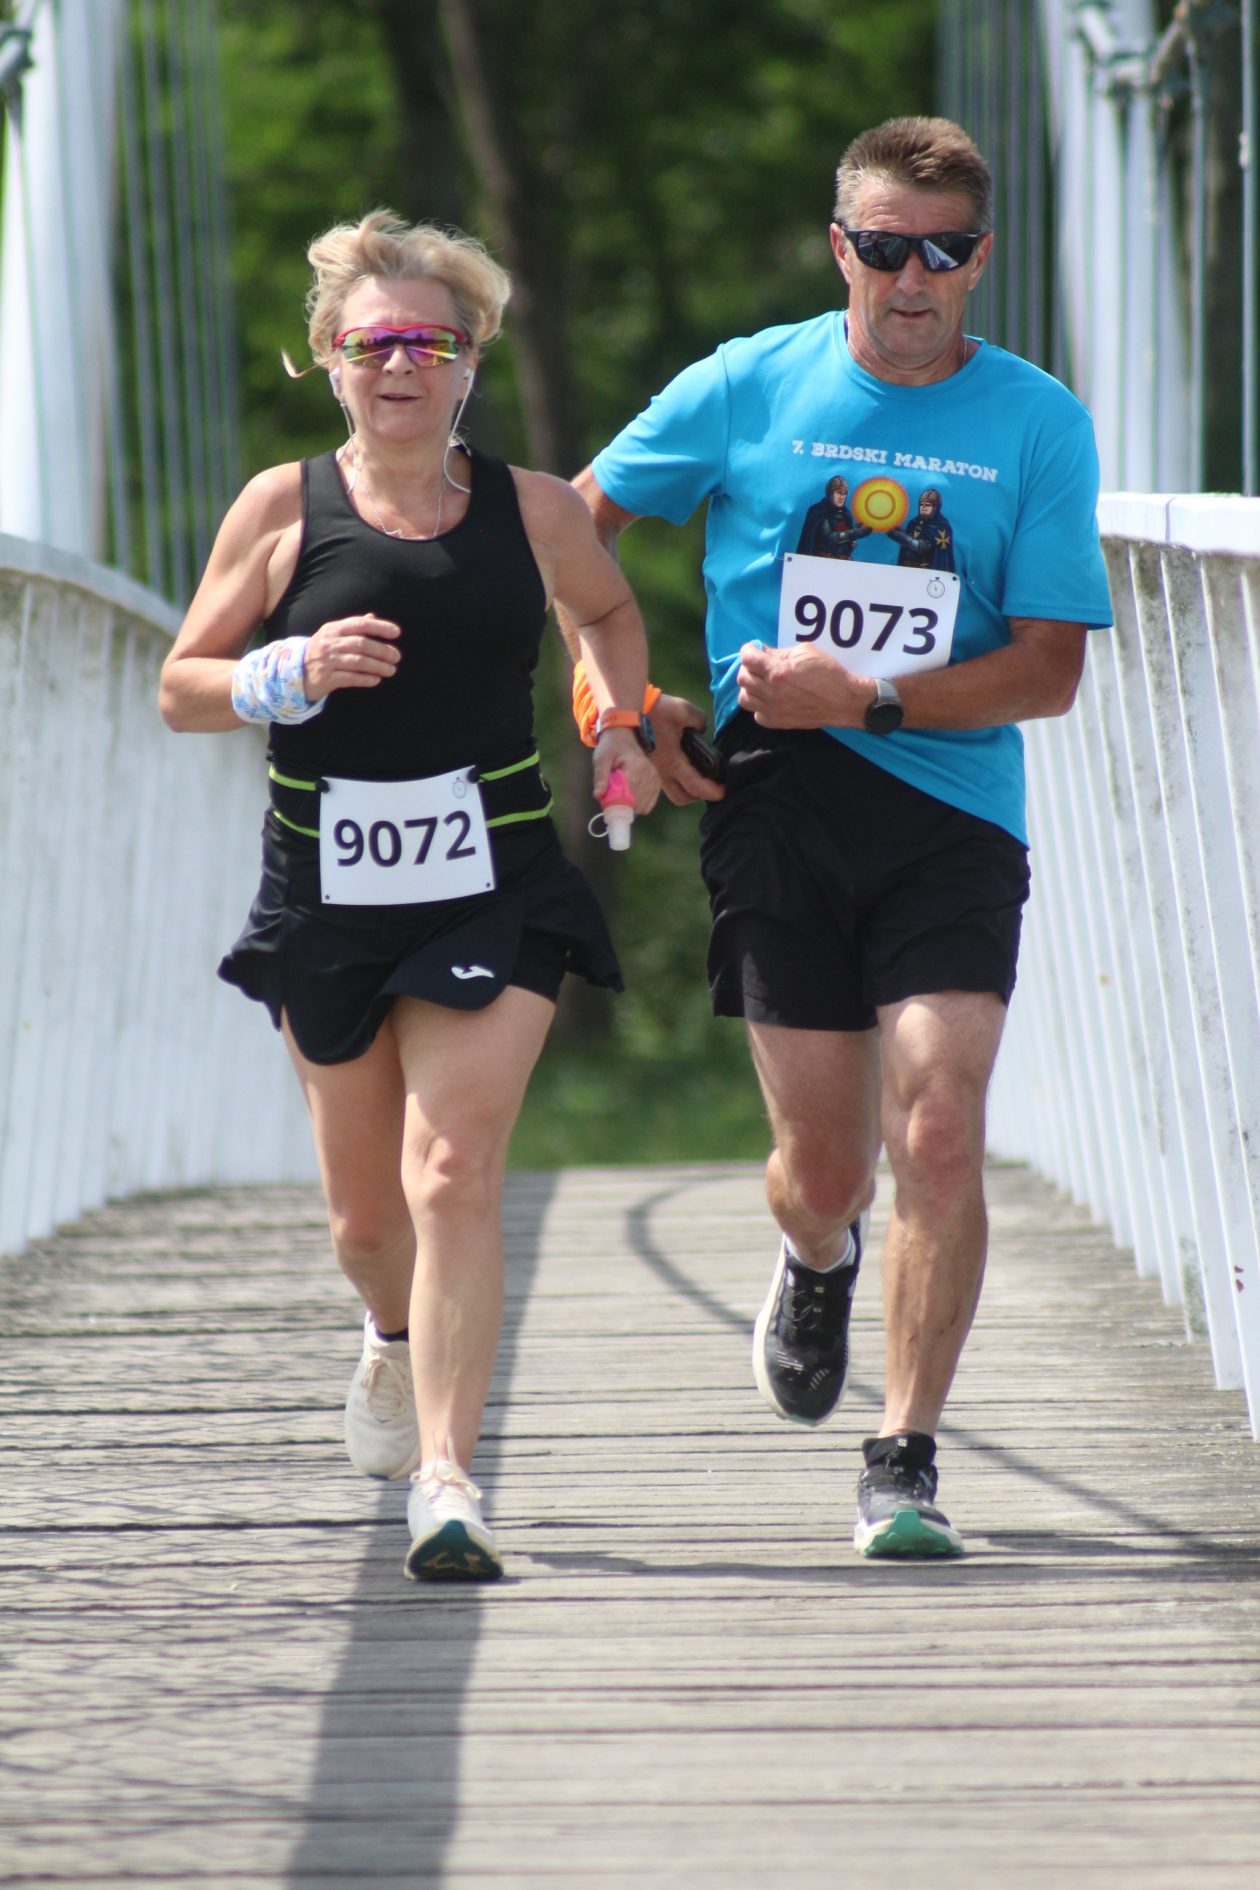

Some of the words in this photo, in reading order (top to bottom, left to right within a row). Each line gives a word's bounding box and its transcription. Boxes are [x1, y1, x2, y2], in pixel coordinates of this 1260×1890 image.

[810, 442, 888, 464] BRDSKI
[893, 452, 998, 482] MARATON
[794, 594, 939, 656] 9073
[333, 810, 476, 868] 9072
